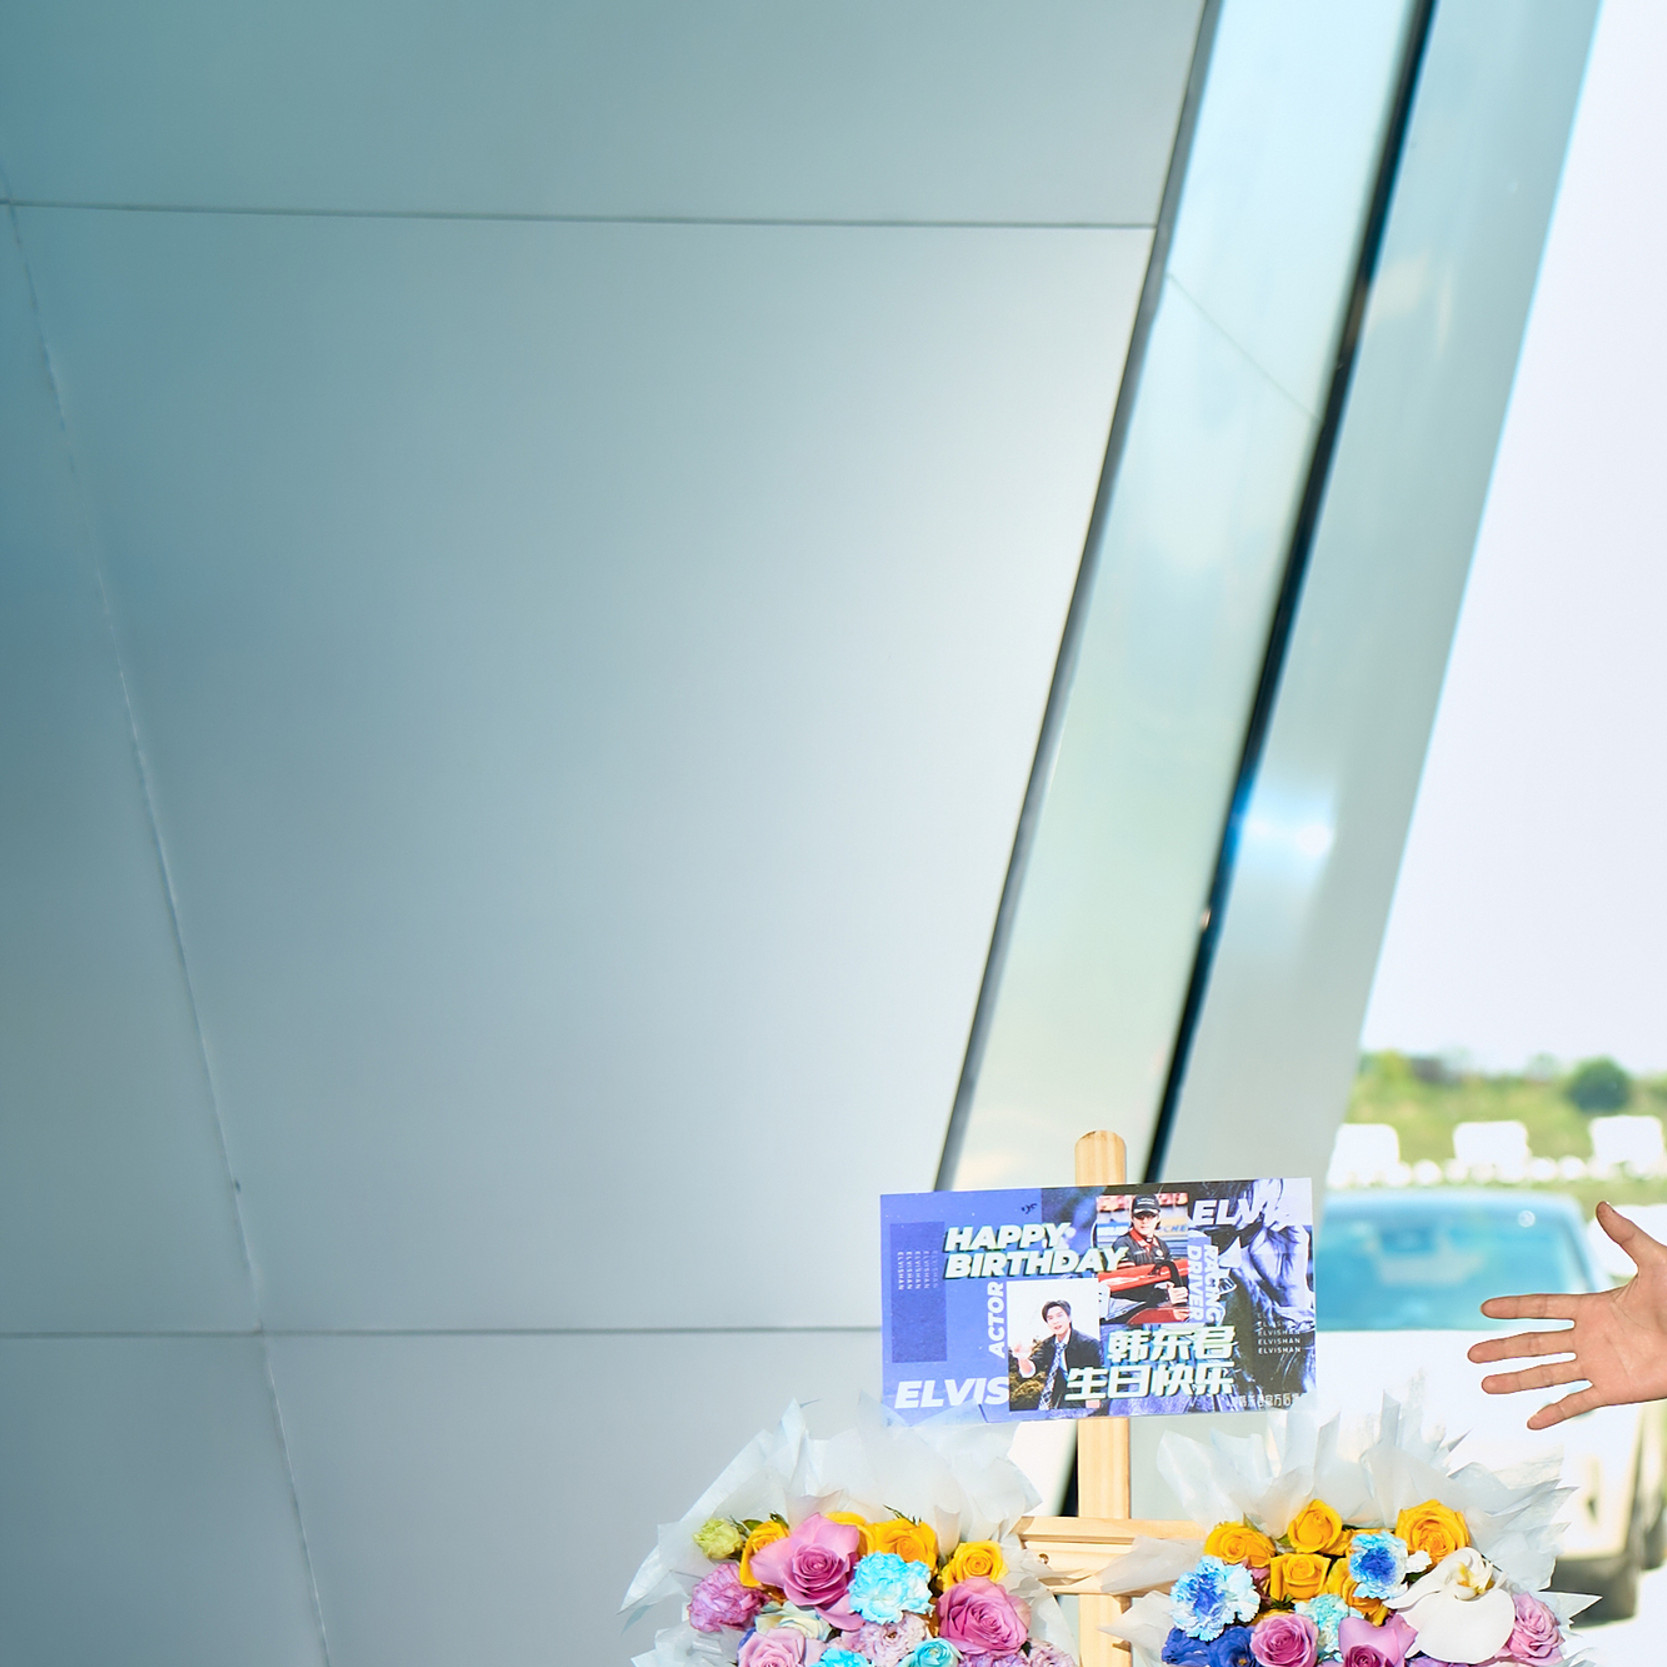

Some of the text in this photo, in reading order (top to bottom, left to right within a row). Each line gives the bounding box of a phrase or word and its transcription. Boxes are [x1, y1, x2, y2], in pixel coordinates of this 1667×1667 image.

[944, 1222, 1071, 1253] HAPPY
[943, 1247, 1128, 1279] BIRTHDAY
[1187, 1244, 1204, 1321] DRIVER
[1203, 1244, 1222, 1322] RACING
[987, 1282, 1006, 1358] ACTOR
[1107, 1325, 1236, 1365] 韩东君
[1258, 1347, 1301, 1355] ELVISHAN
[894, 1376, 1009, 1409] ELVIS
[1064, 1361, 1236, 1402] 生日快乐
